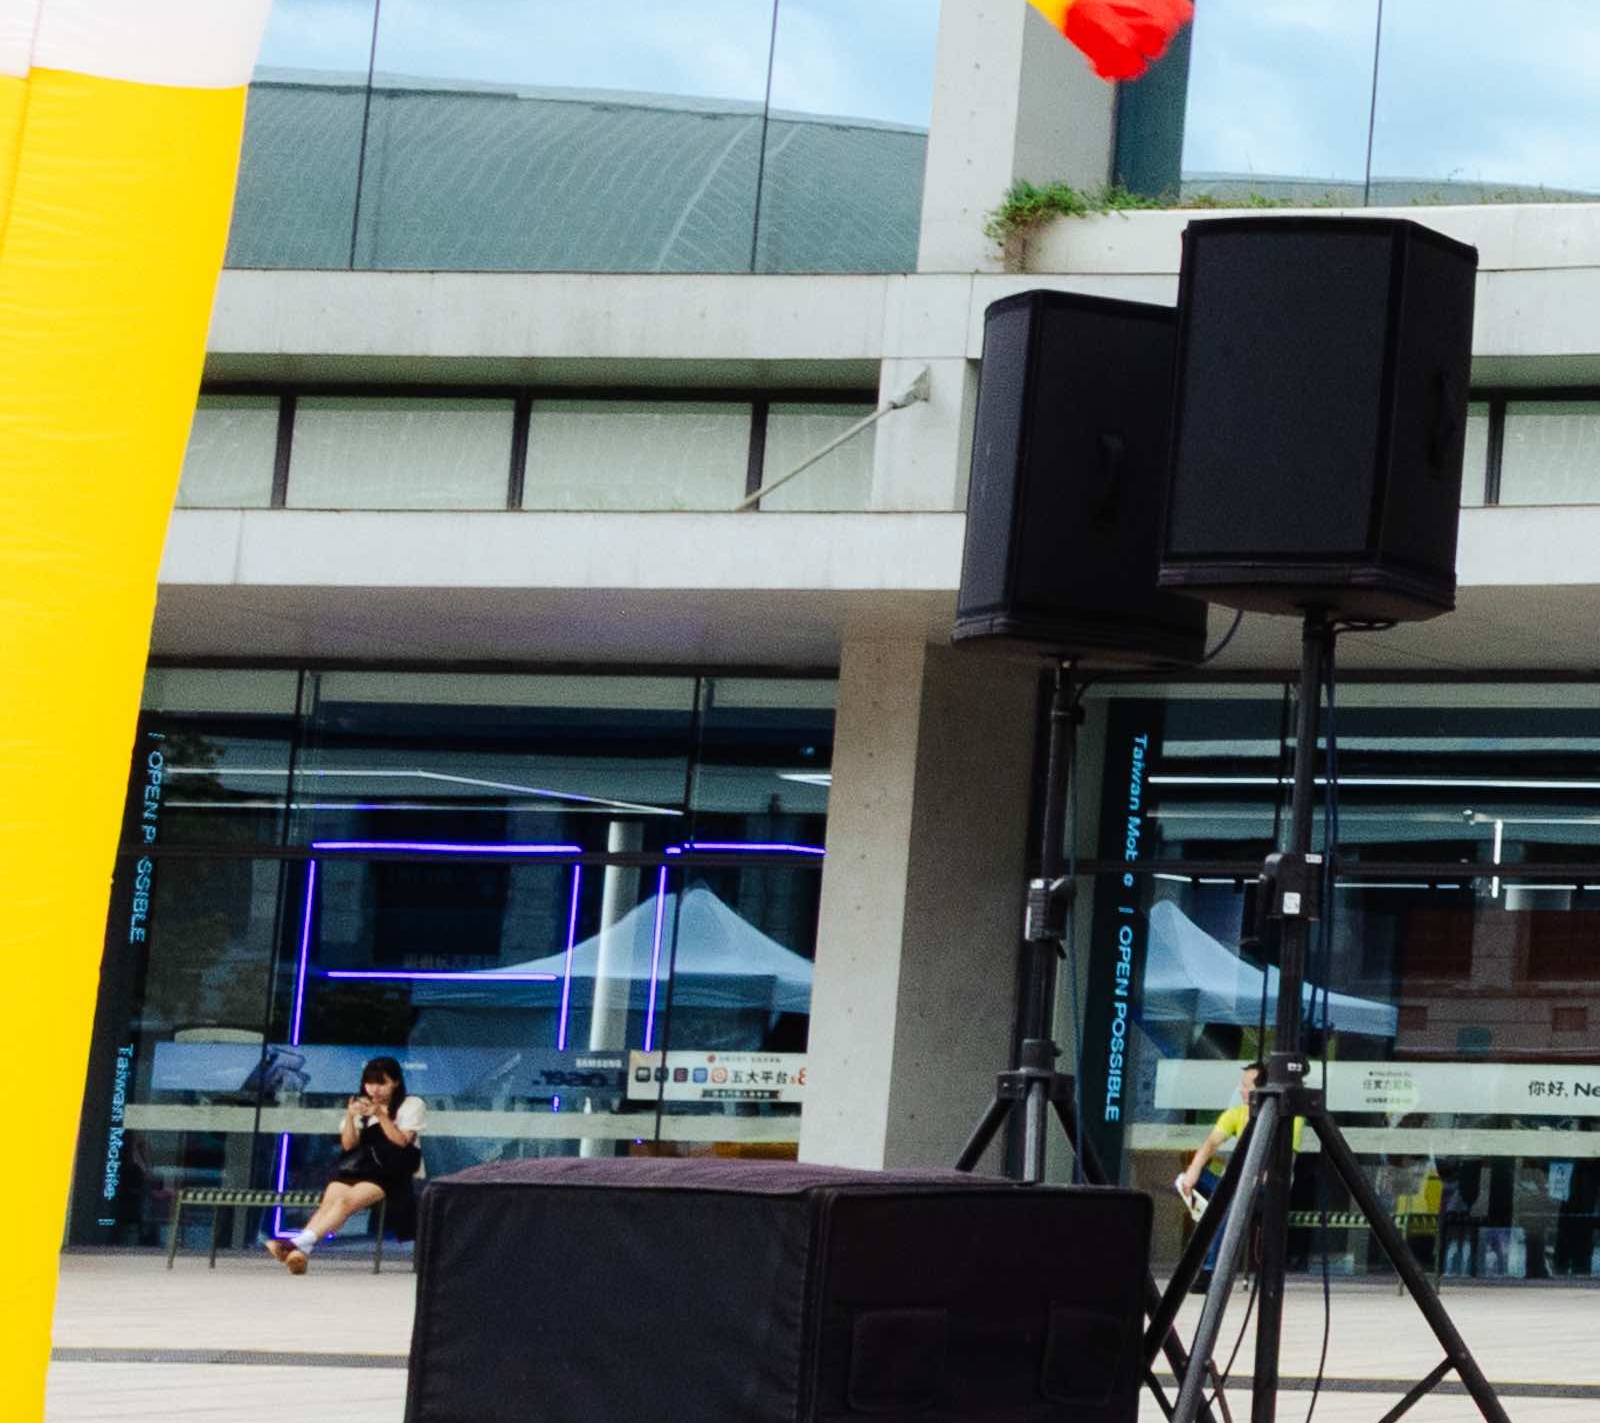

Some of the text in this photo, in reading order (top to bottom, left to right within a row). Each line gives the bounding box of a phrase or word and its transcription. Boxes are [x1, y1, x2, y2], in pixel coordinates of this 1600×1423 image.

[128, 750, 165, 945] OPEN PSSIBLE
[1122, 733, 1148, 887] Taiwan Mobe
[1104, 925, 1133, 1122] OPEN POSSIBLE
